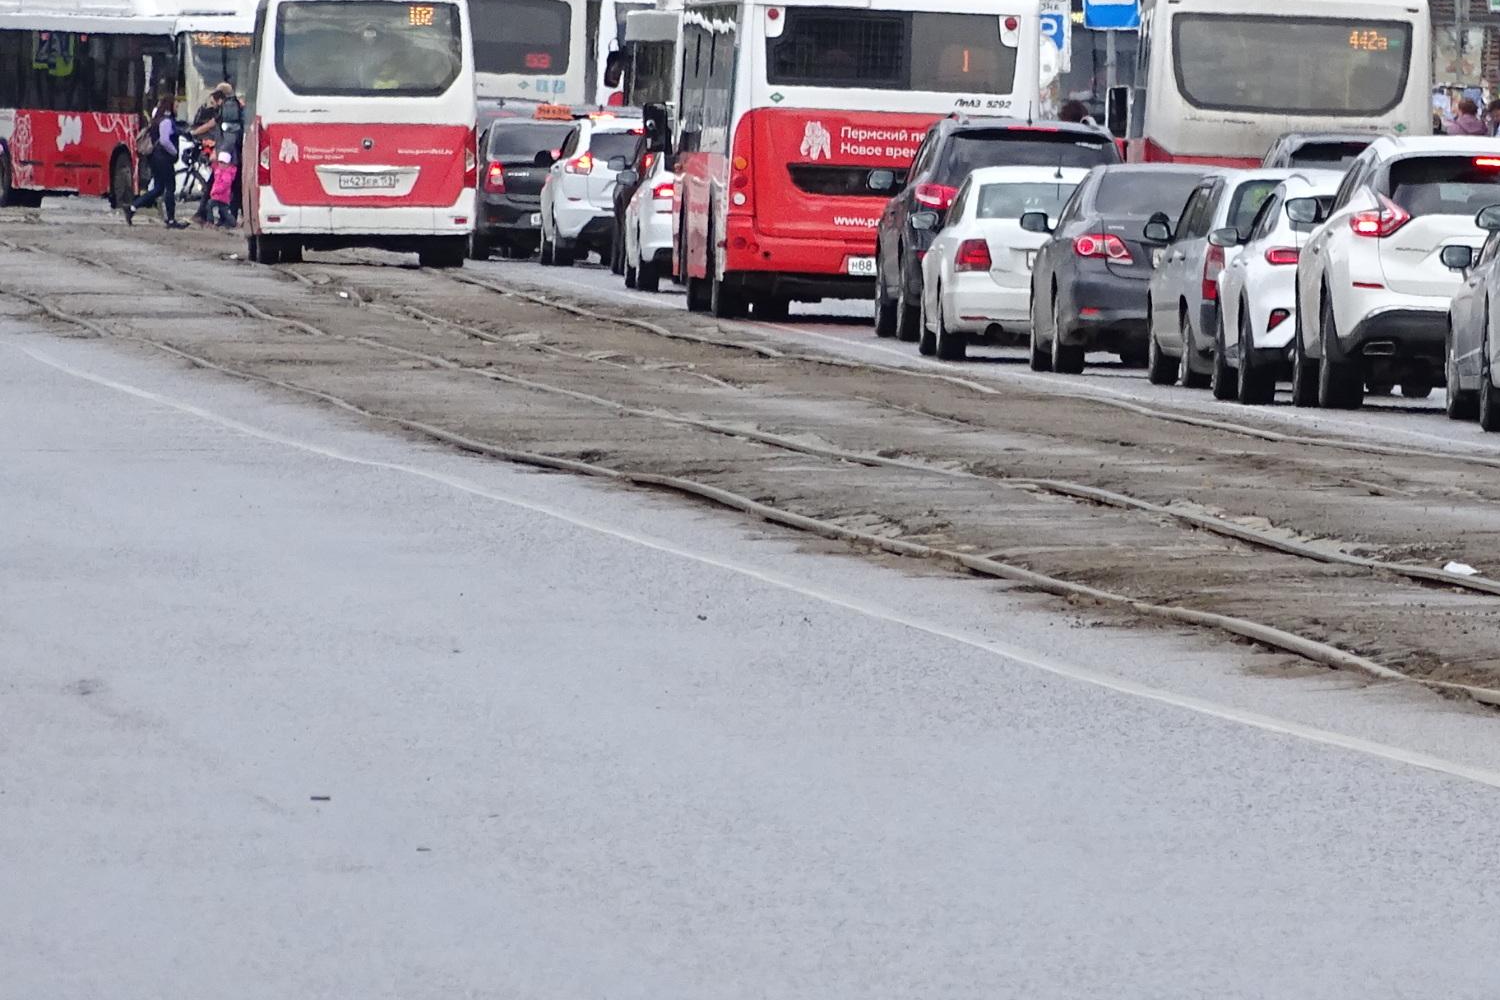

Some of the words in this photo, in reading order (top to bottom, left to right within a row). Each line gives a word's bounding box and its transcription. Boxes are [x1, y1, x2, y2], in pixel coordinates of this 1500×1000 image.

[409, 5, 435, 27] 102
[840, 126, 908, 142] Пермский
[840, 142, 882, 156] Новое
